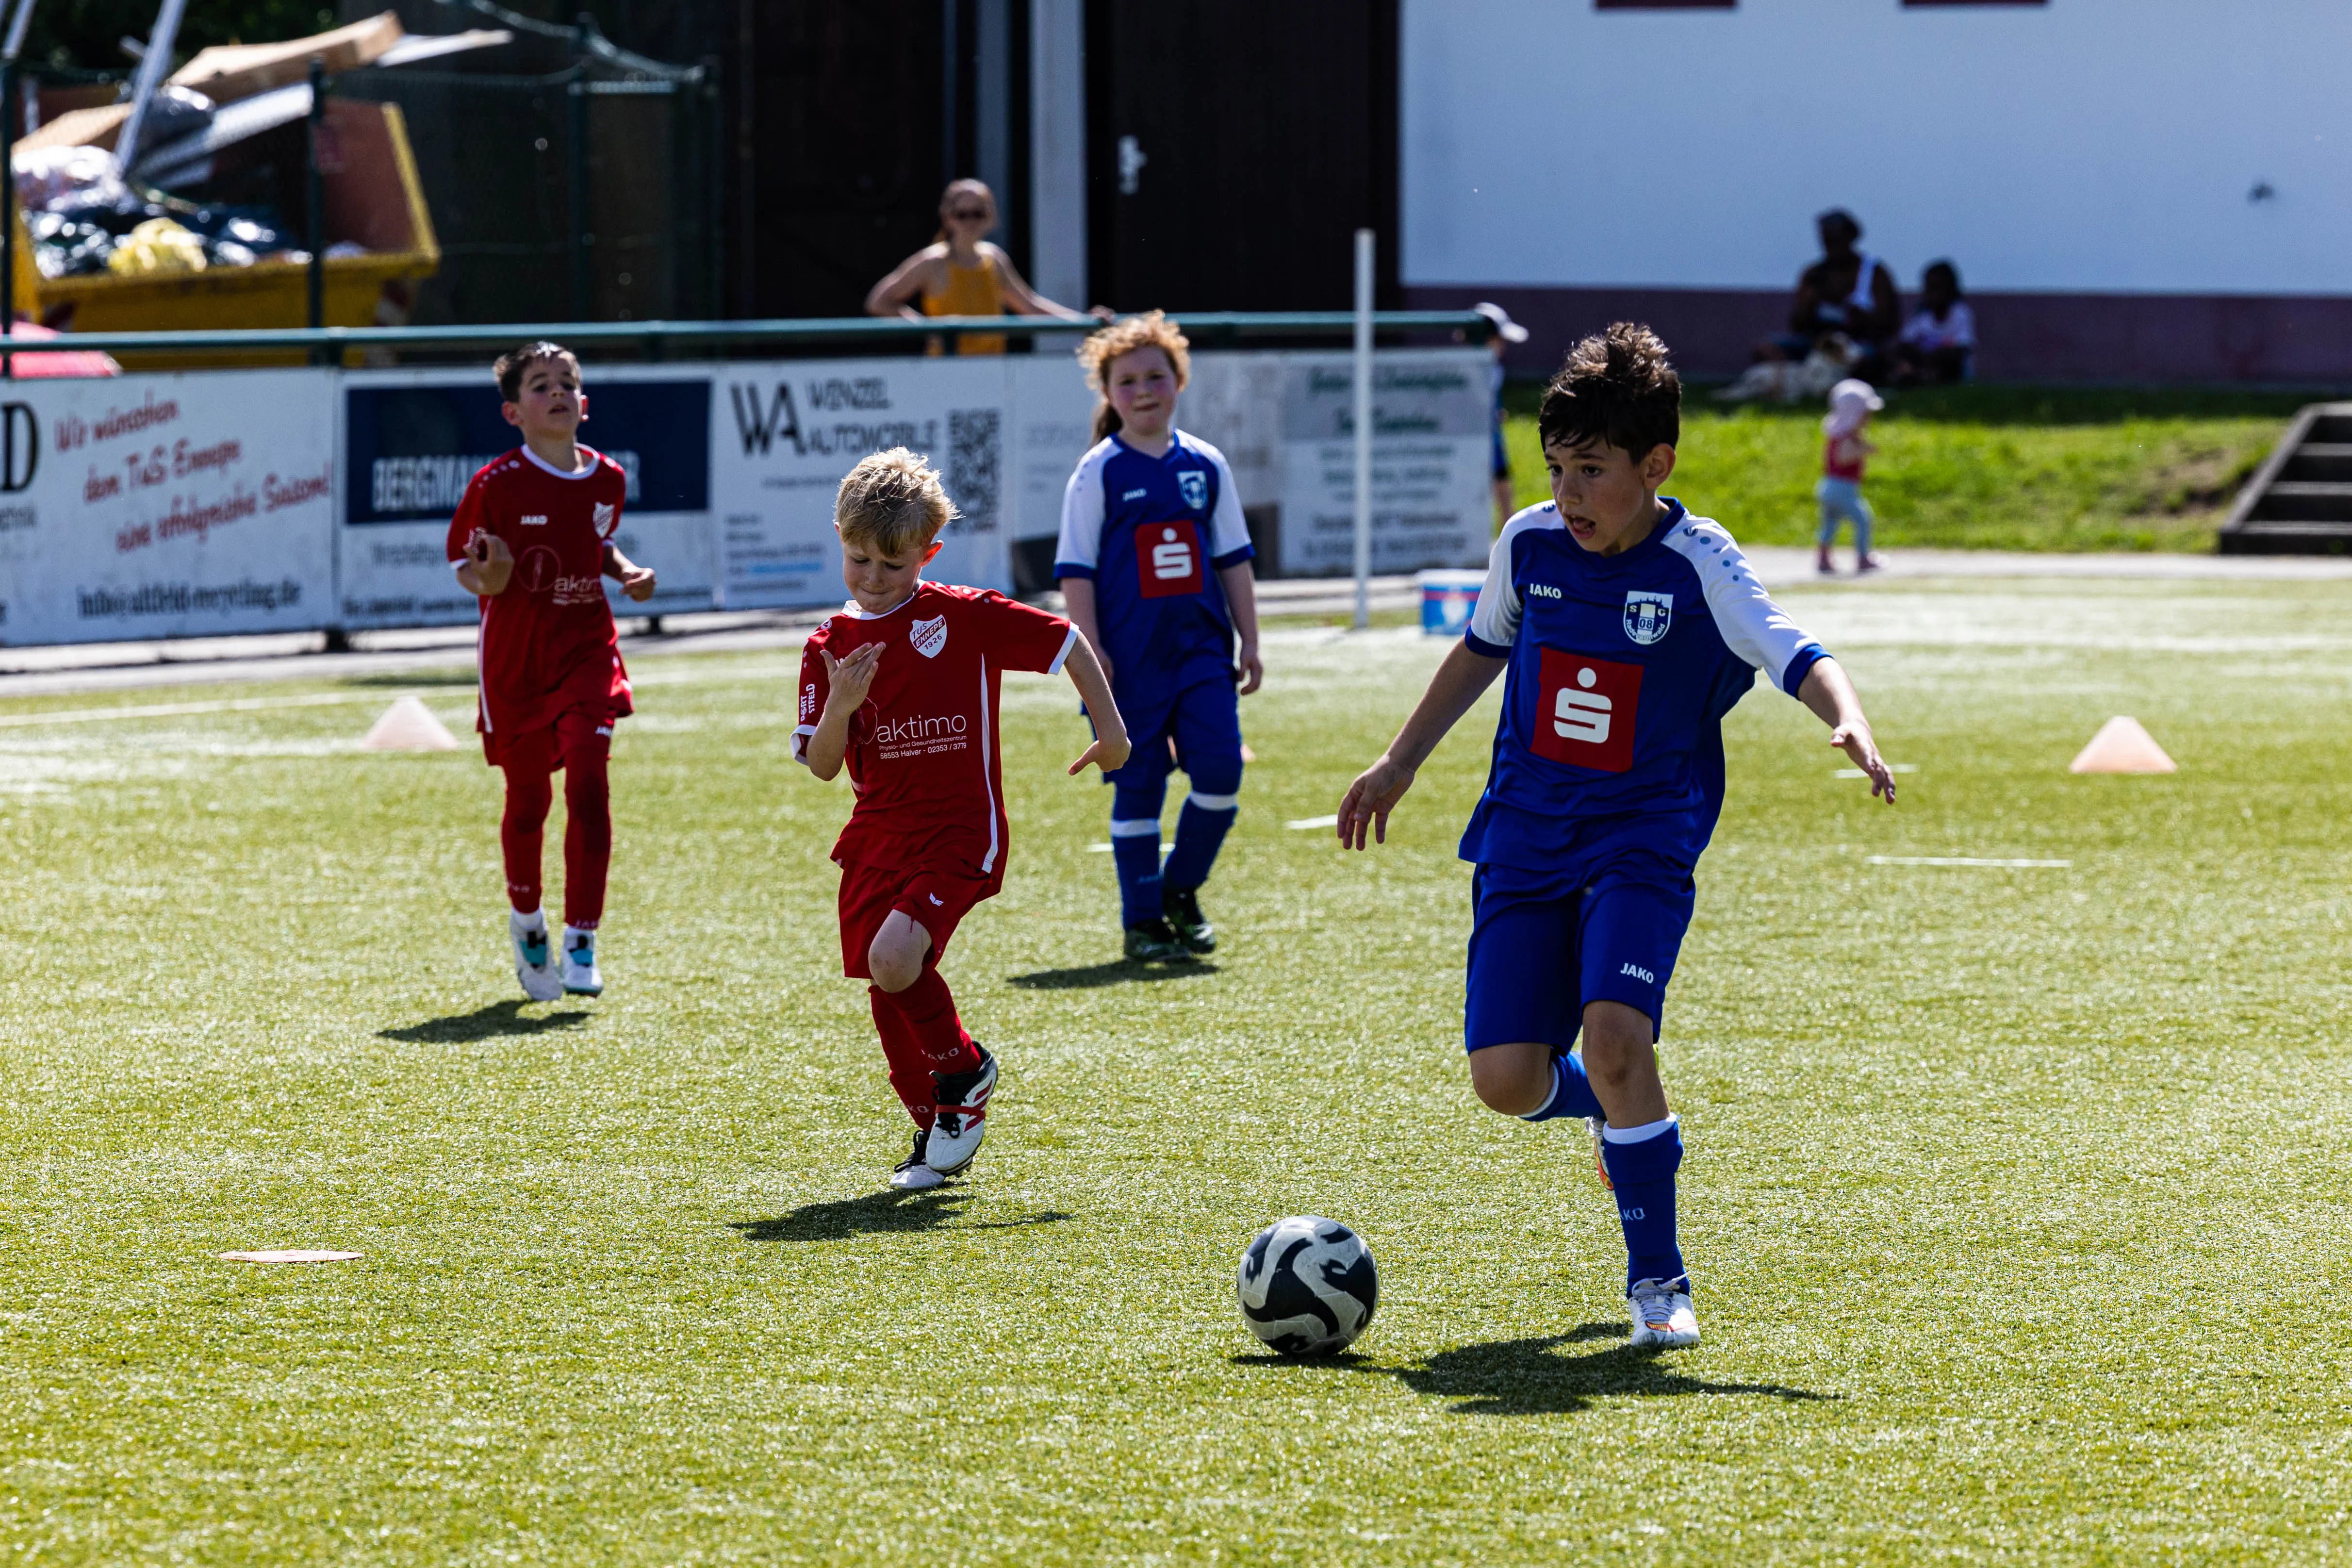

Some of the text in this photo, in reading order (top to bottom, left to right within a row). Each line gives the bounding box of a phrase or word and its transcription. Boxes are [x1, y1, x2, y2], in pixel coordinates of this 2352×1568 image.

[729, 380, 808, 457] WA
[1530, 583, 1562, 599] JAKO
[912, 623, 927, 639] TUS
[1640, 619, 1653, 629] 08
[916, 619, 943, 647] ENNEPE
[924, 634, 942, 650] 1926
[877, 714, 967, 743] aktimo
[911, 735, 967, 747] Gesundheitszentrum
[880, 751, 900, 759] 58553
[901, 749, 921, 758] Halver
[927, 745, 948, 754] 02353
[1620, 962, 1654, 984] JAKO
